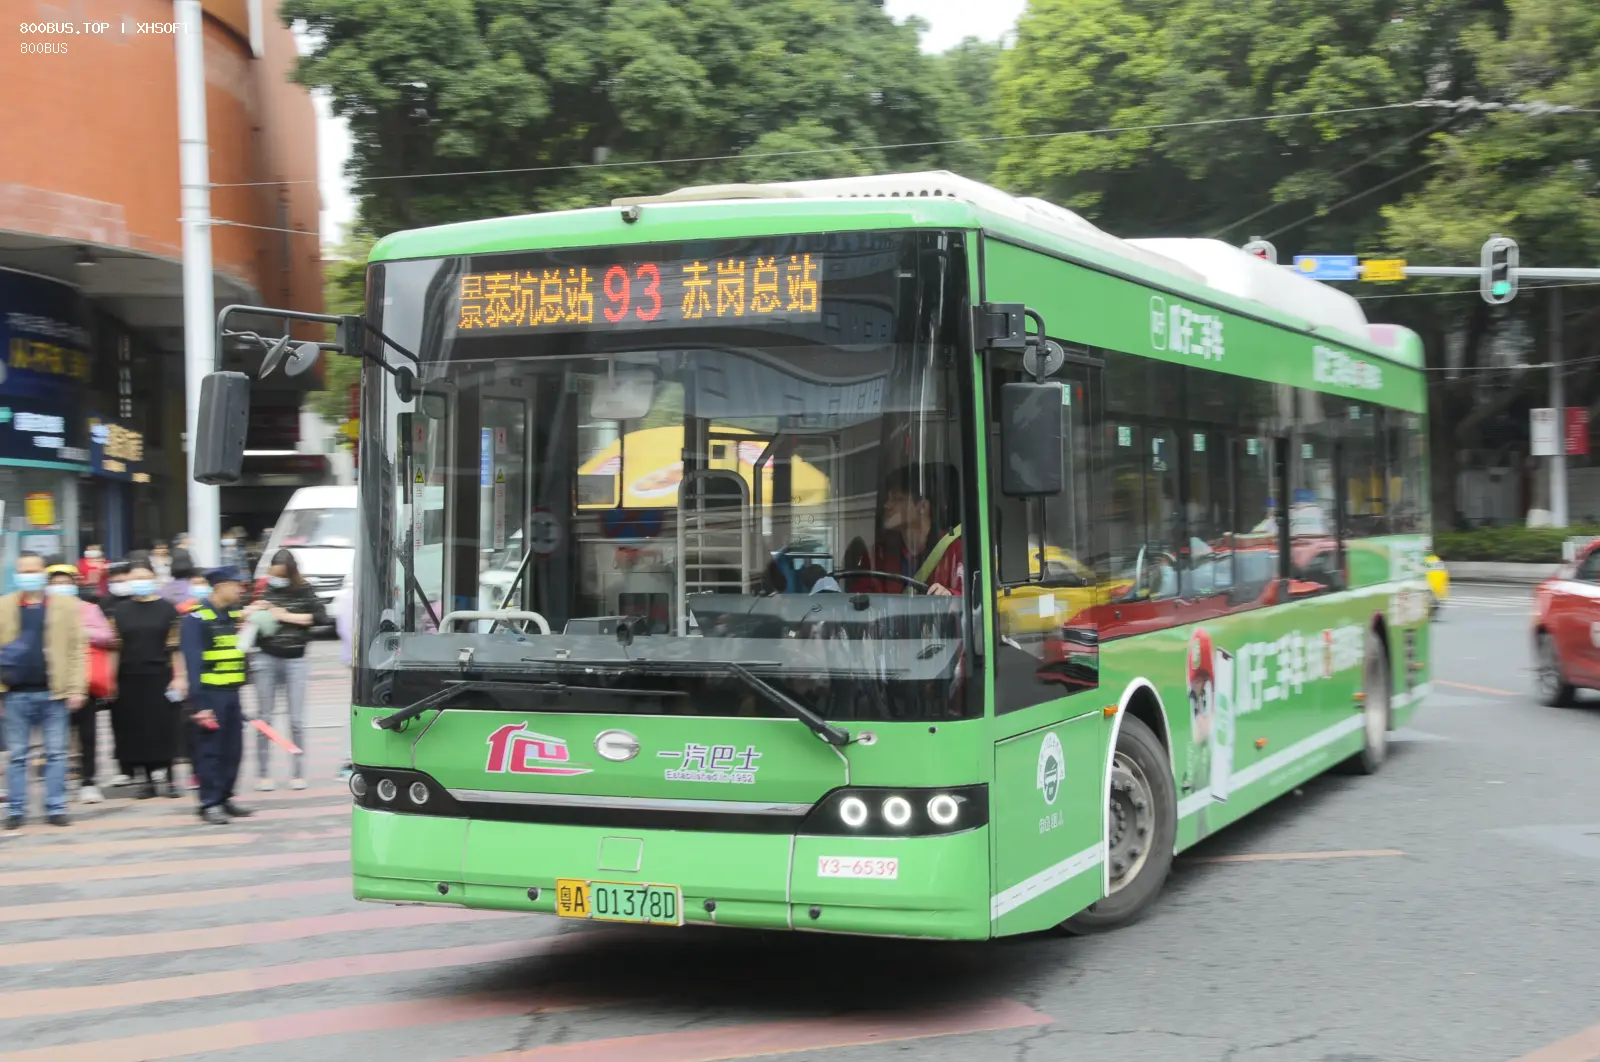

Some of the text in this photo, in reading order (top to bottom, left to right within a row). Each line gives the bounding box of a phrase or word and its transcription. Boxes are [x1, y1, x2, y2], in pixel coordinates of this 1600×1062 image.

[458, 253, 817, 329] 景泰坑总站 93 赤岗总站
[658, 744, 761, 771] 一汽巴士
[819, 857, 897, 877] Y3-6539
[560, 885, 675, 919] 粤A 01378D
